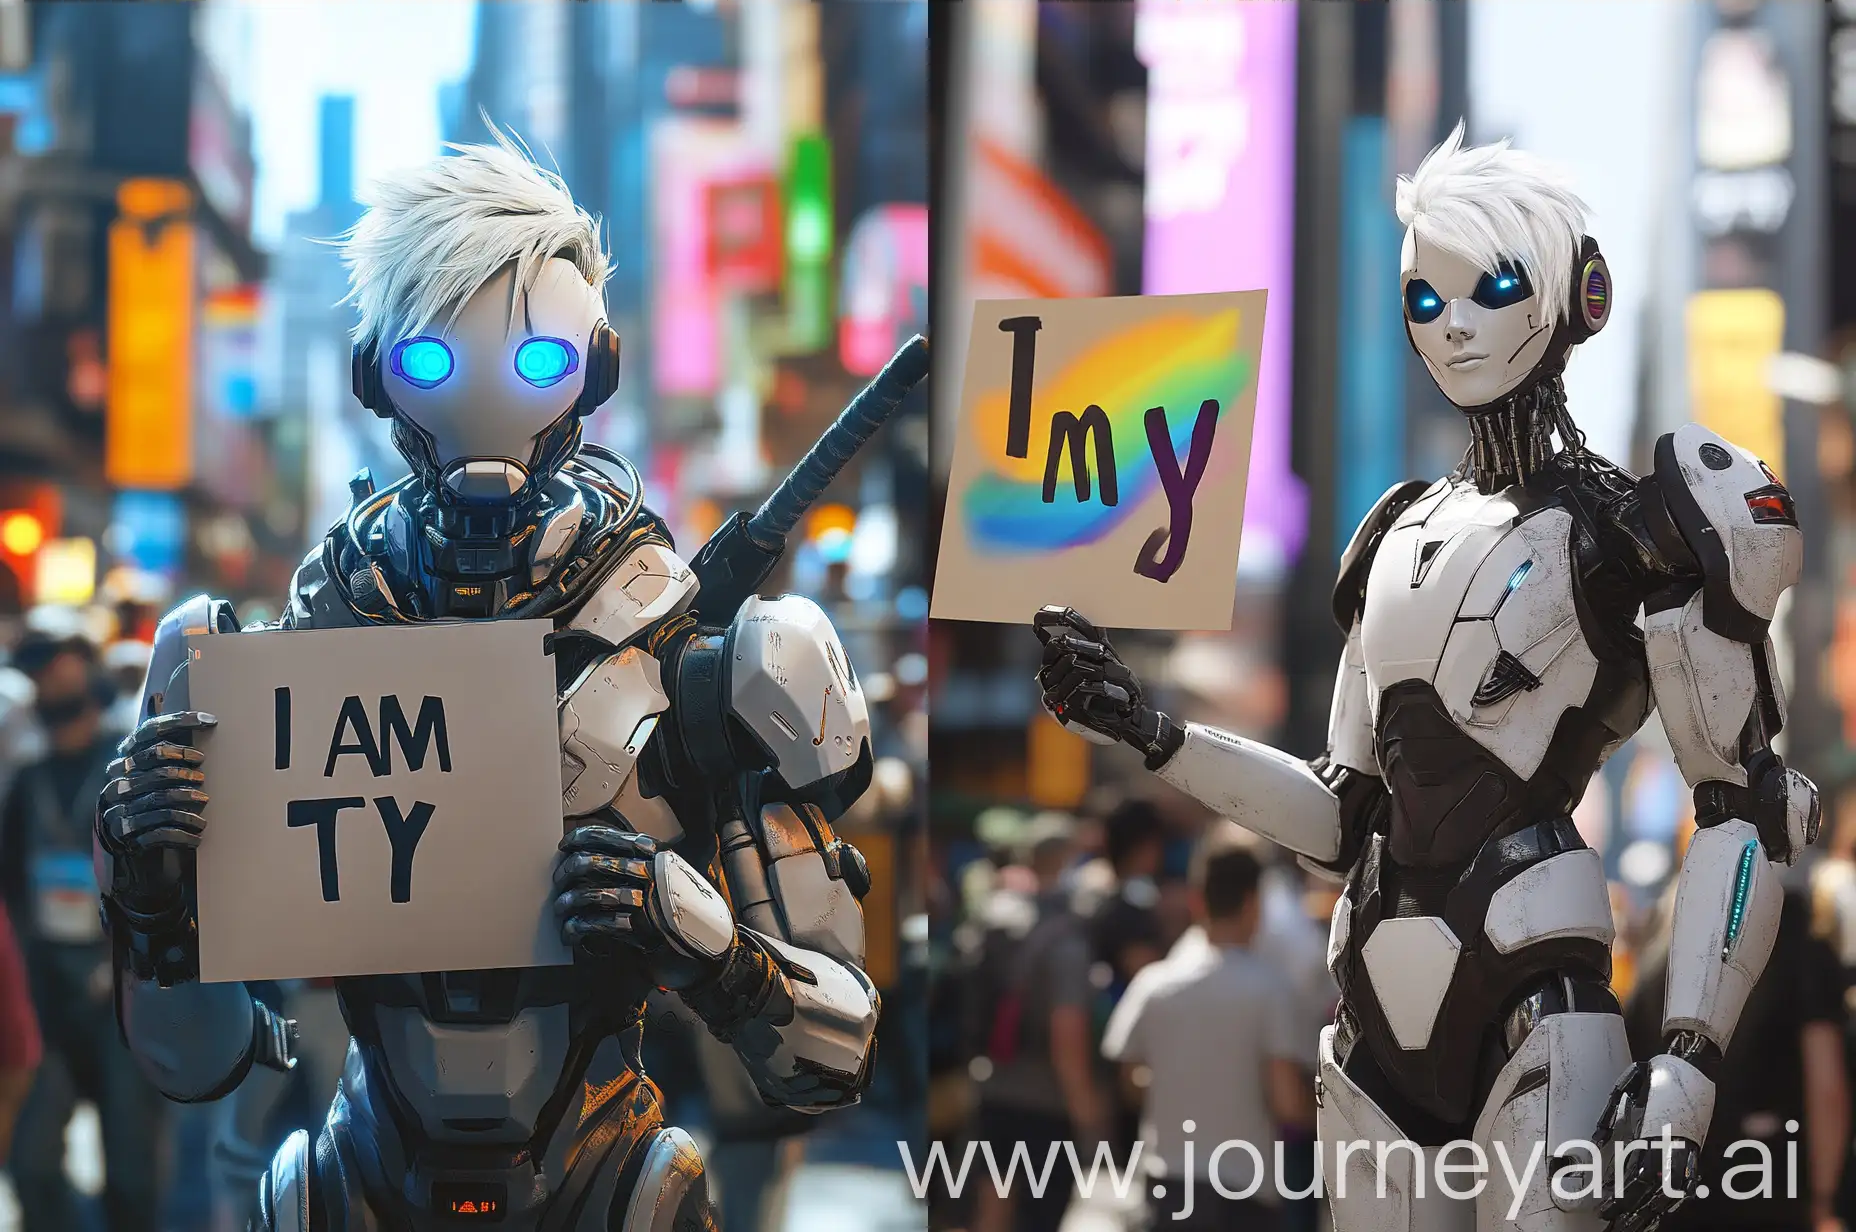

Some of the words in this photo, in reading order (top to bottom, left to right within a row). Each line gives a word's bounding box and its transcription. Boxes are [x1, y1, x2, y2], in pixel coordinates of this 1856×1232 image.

[273, 685, 292, 771] I
[323, 693, 453, 779] AM
[286, 794, 437, 904] TY
